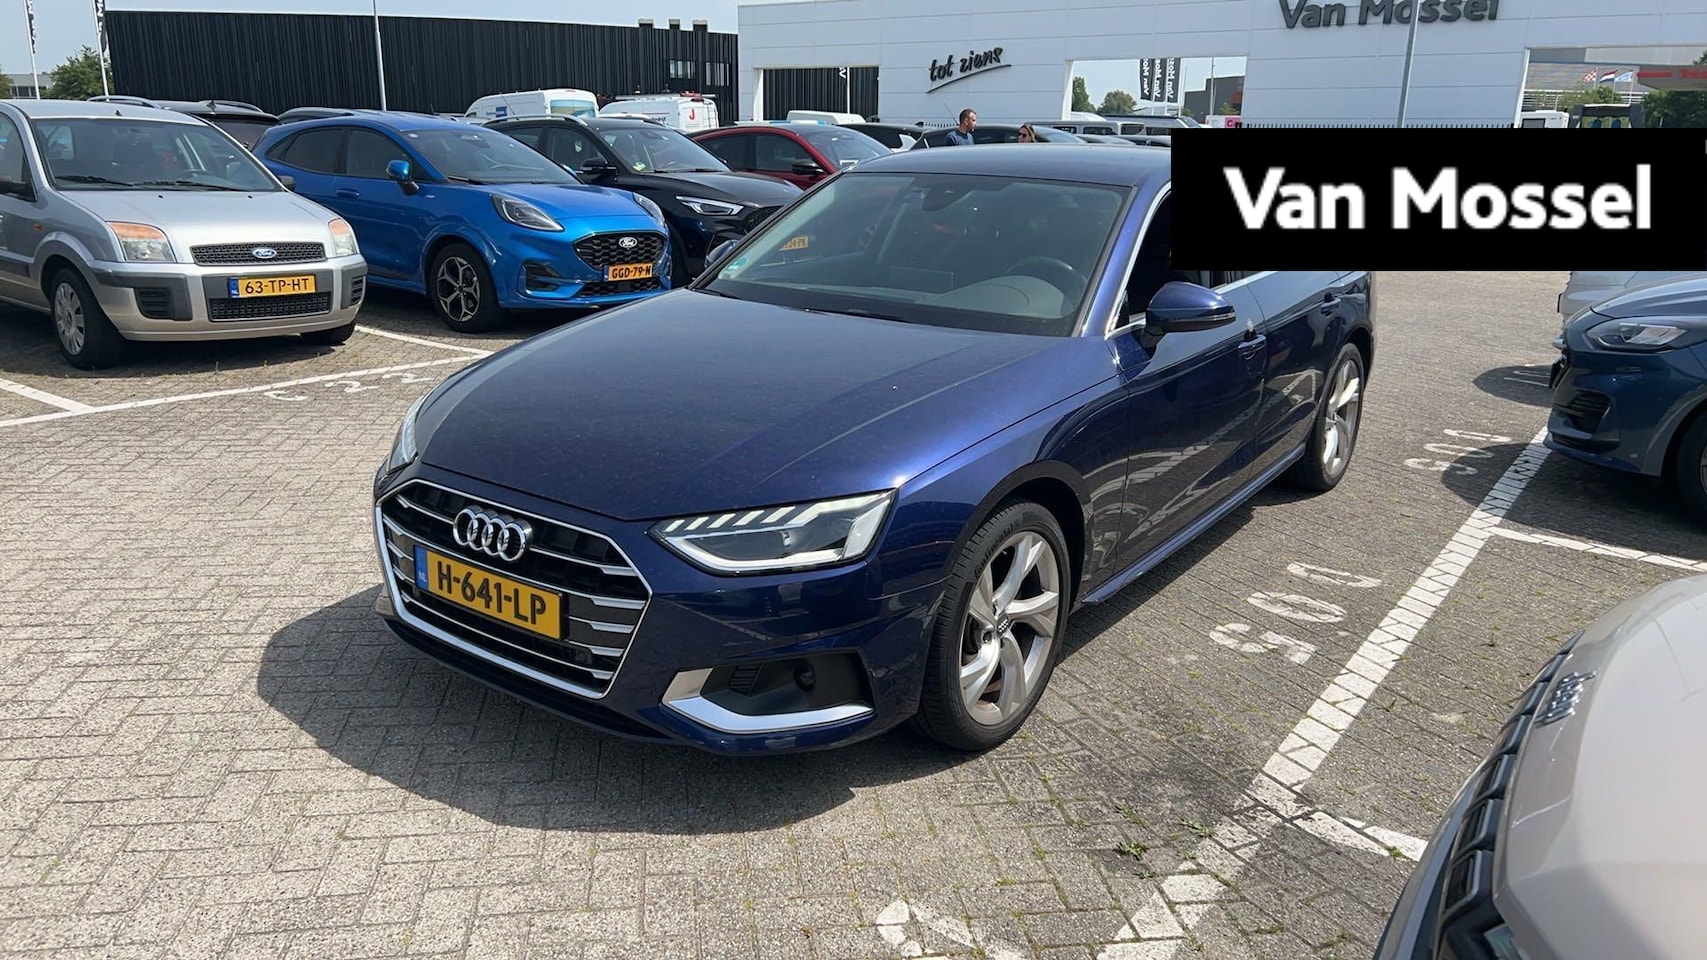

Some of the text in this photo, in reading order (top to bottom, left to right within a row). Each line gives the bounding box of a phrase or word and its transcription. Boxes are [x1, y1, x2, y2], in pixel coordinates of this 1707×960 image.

[1278, 0, 1500, 29] Van Mossel
[928, 55, 954, 81] tot
[611, 265, 651, 279] GGD-79-N
[245, 278, 309, 294] 63-TP-HT
[418, 570, 427, 583] NL
[437, 561, 546, 625] H-641-LP
